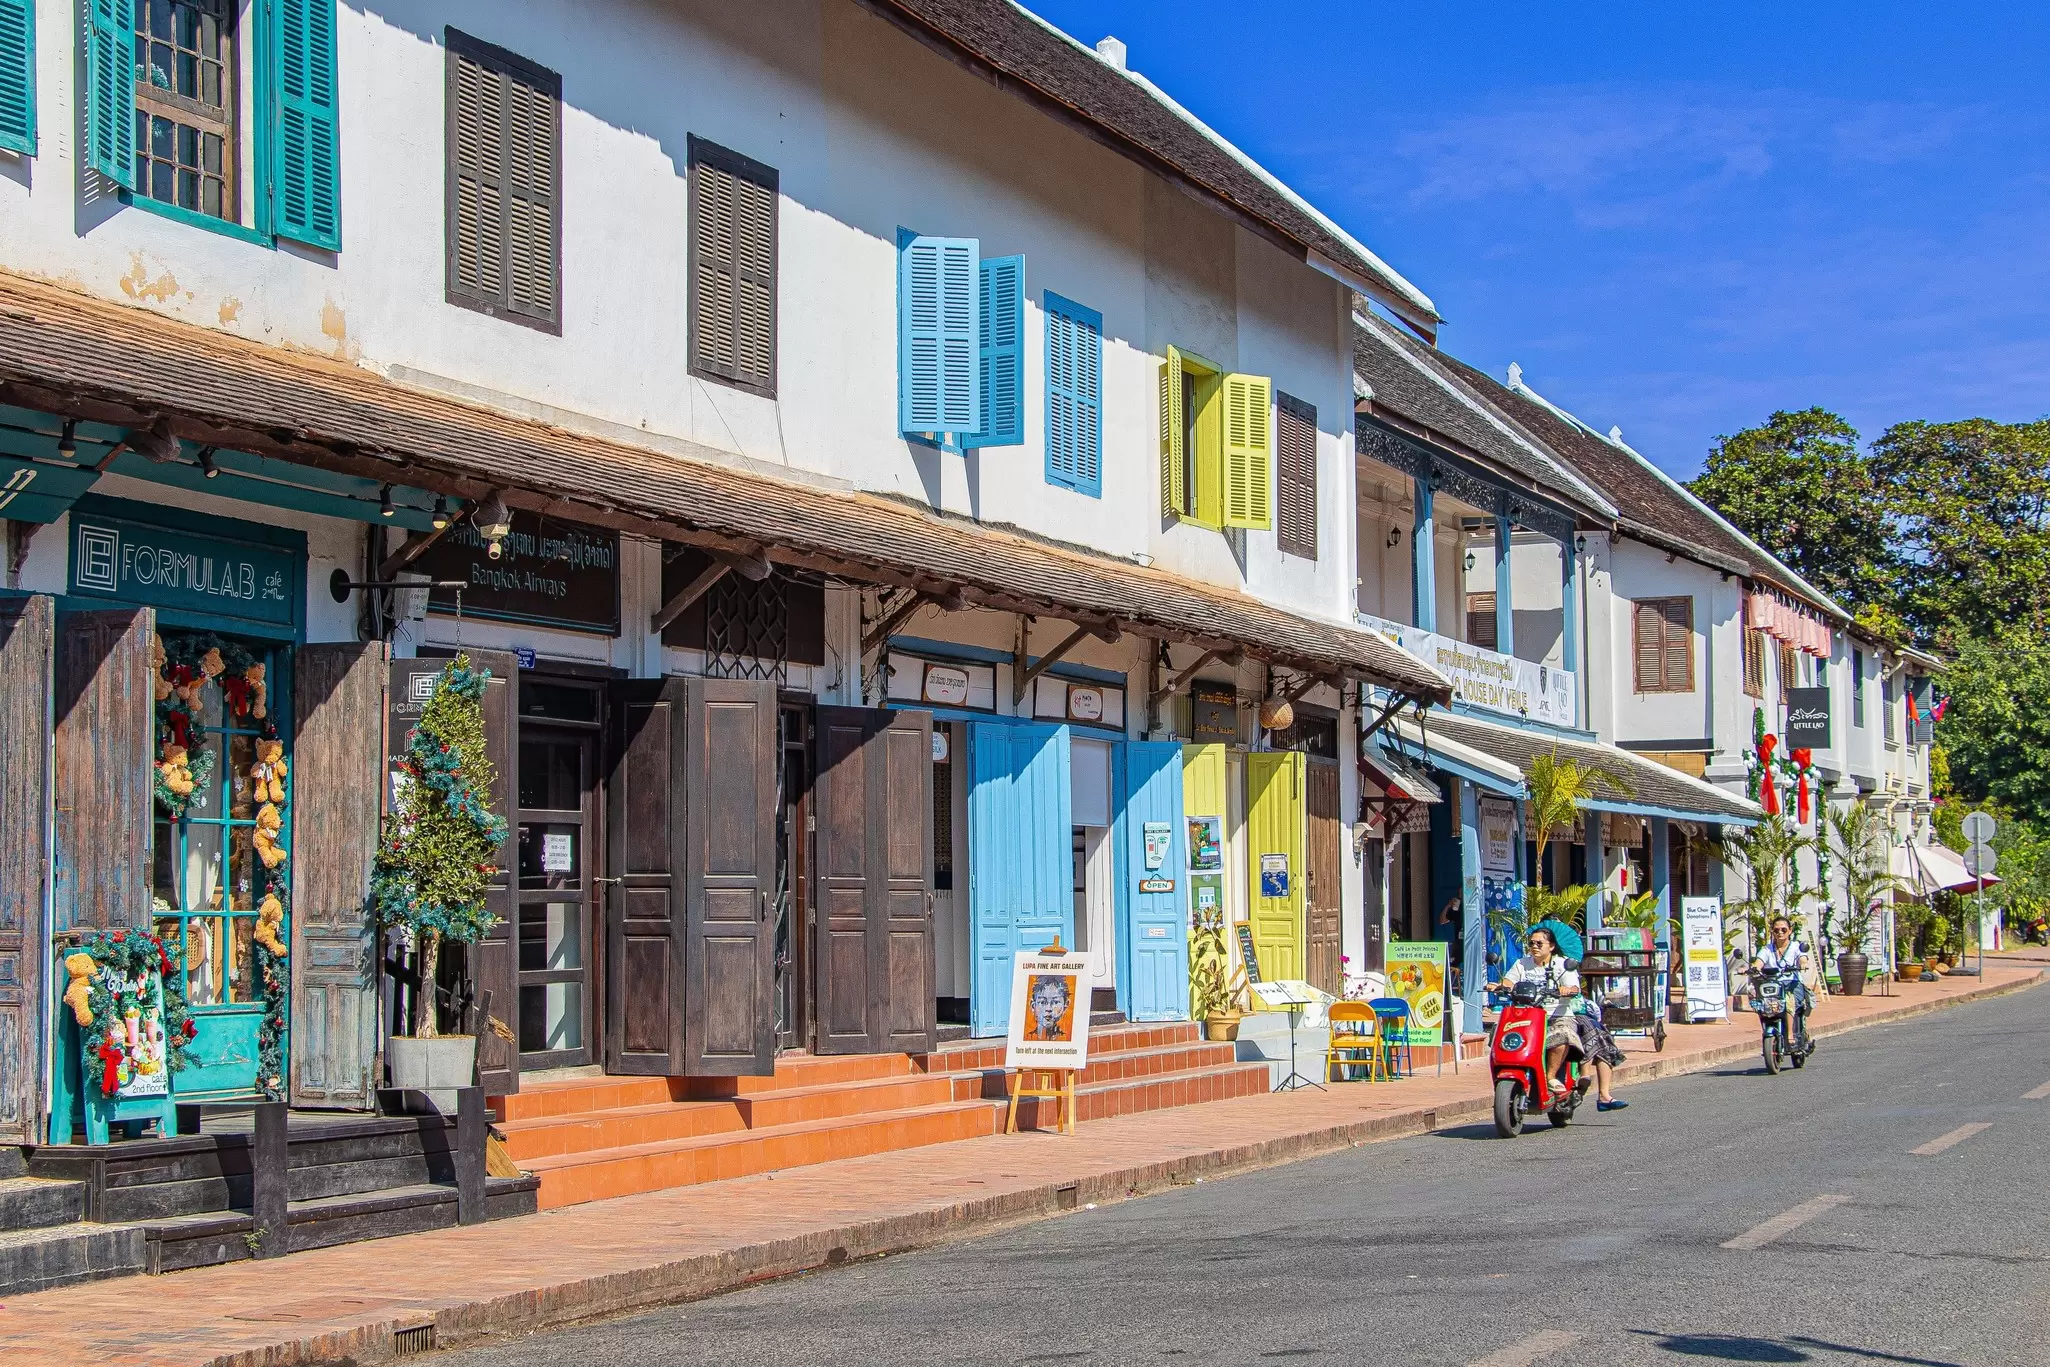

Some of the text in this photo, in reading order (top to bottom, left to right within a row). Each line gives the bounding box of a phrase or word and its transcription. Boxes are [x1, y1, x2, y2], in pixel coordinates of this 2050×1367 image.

[265, 571, 282, 587] café
[471, 562, 567, 600] Bangkok Airways
[1463, 679, 1487, 702] HOUSE
[1489, 684, 1504, 707] DAY
[152, 1074, 167, 1083] cafe
[132, 1083, 163, 1094] 2nd floor
